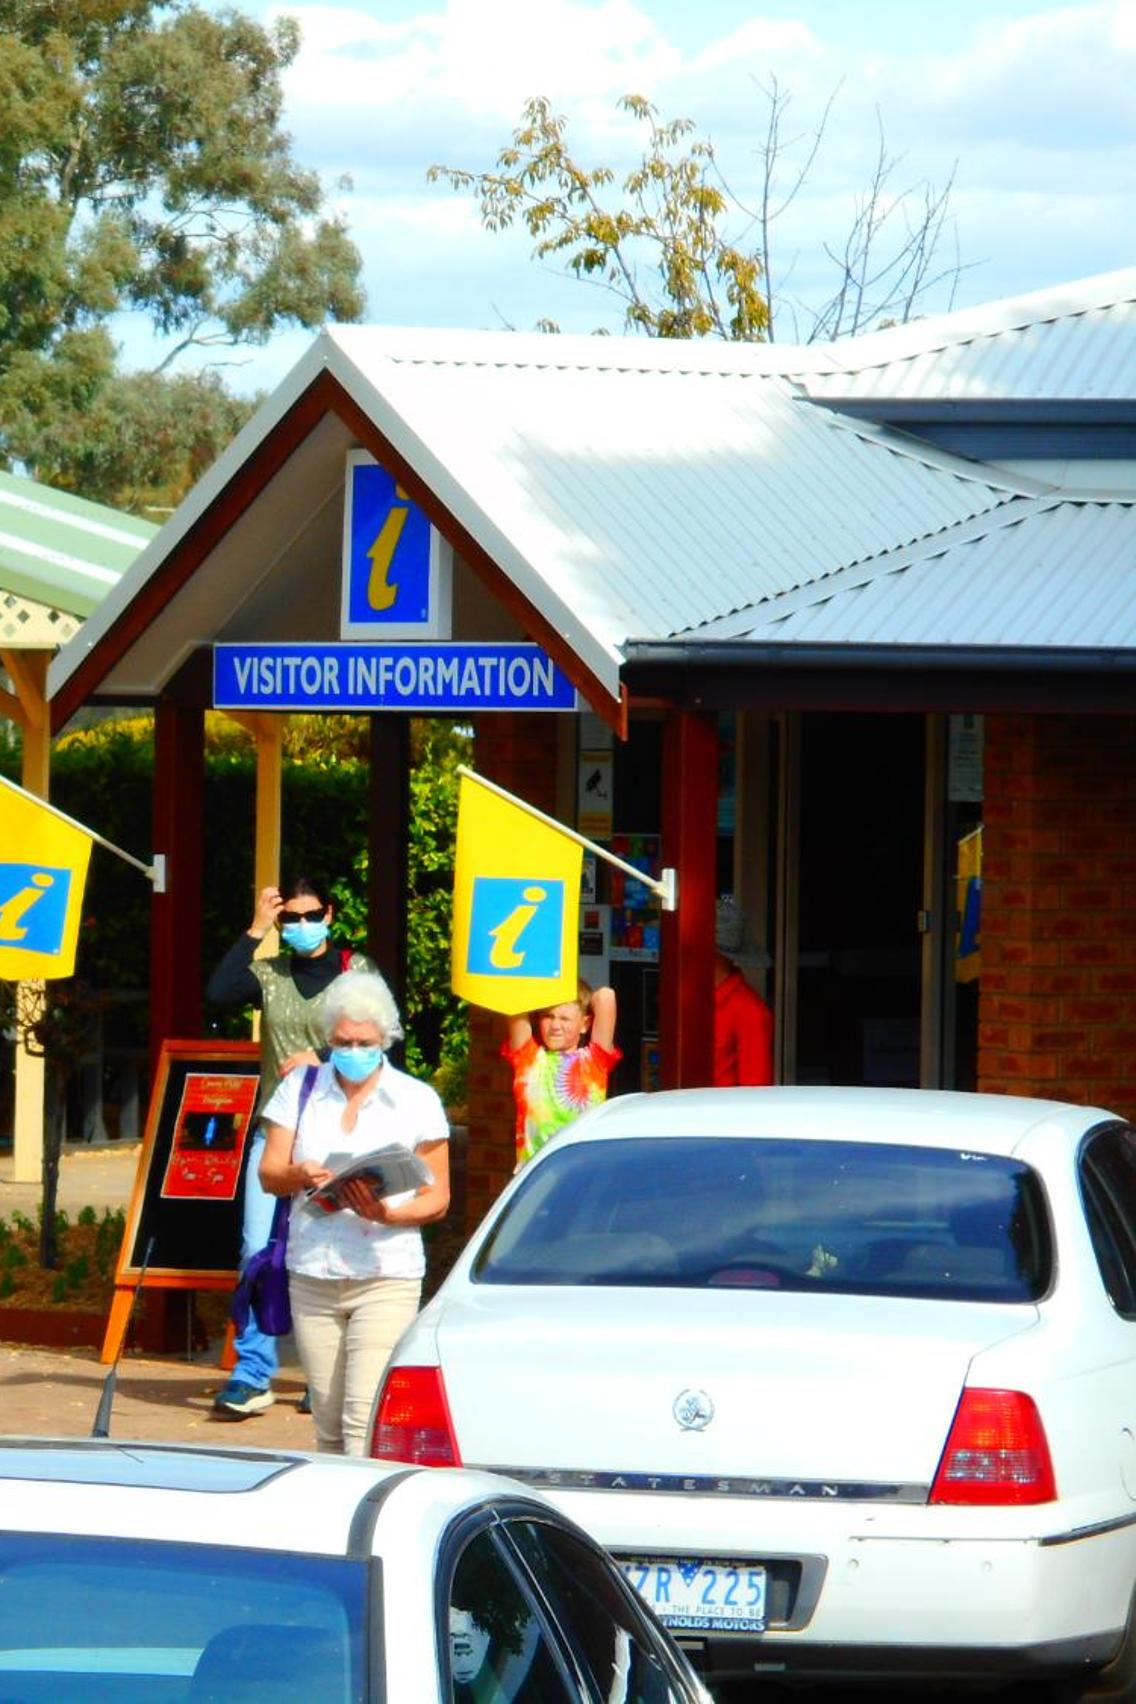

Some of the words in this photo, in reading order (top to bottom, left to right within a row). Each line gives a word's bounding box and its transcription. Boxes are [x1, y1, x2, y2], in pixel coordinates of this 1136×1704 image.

[232, 656, 341, 696] VISITOR
[348, 656, 555, 697] INFORMATION
[487, 886, 547, 969] i
[548, 1472, 839, 1496] STATESMAN
[625, 1565, 672, 1602] ZR
[701, 1569, 763, 1606] 225
[672, 1604, 690, 1615] THE
[695, 1605, 725, 1616] PLACE
[731, 1606, 743, 1617] TO
[749, 1607, 762, 1617] BE
[711, 1617, 765, 1631] MOTORS
